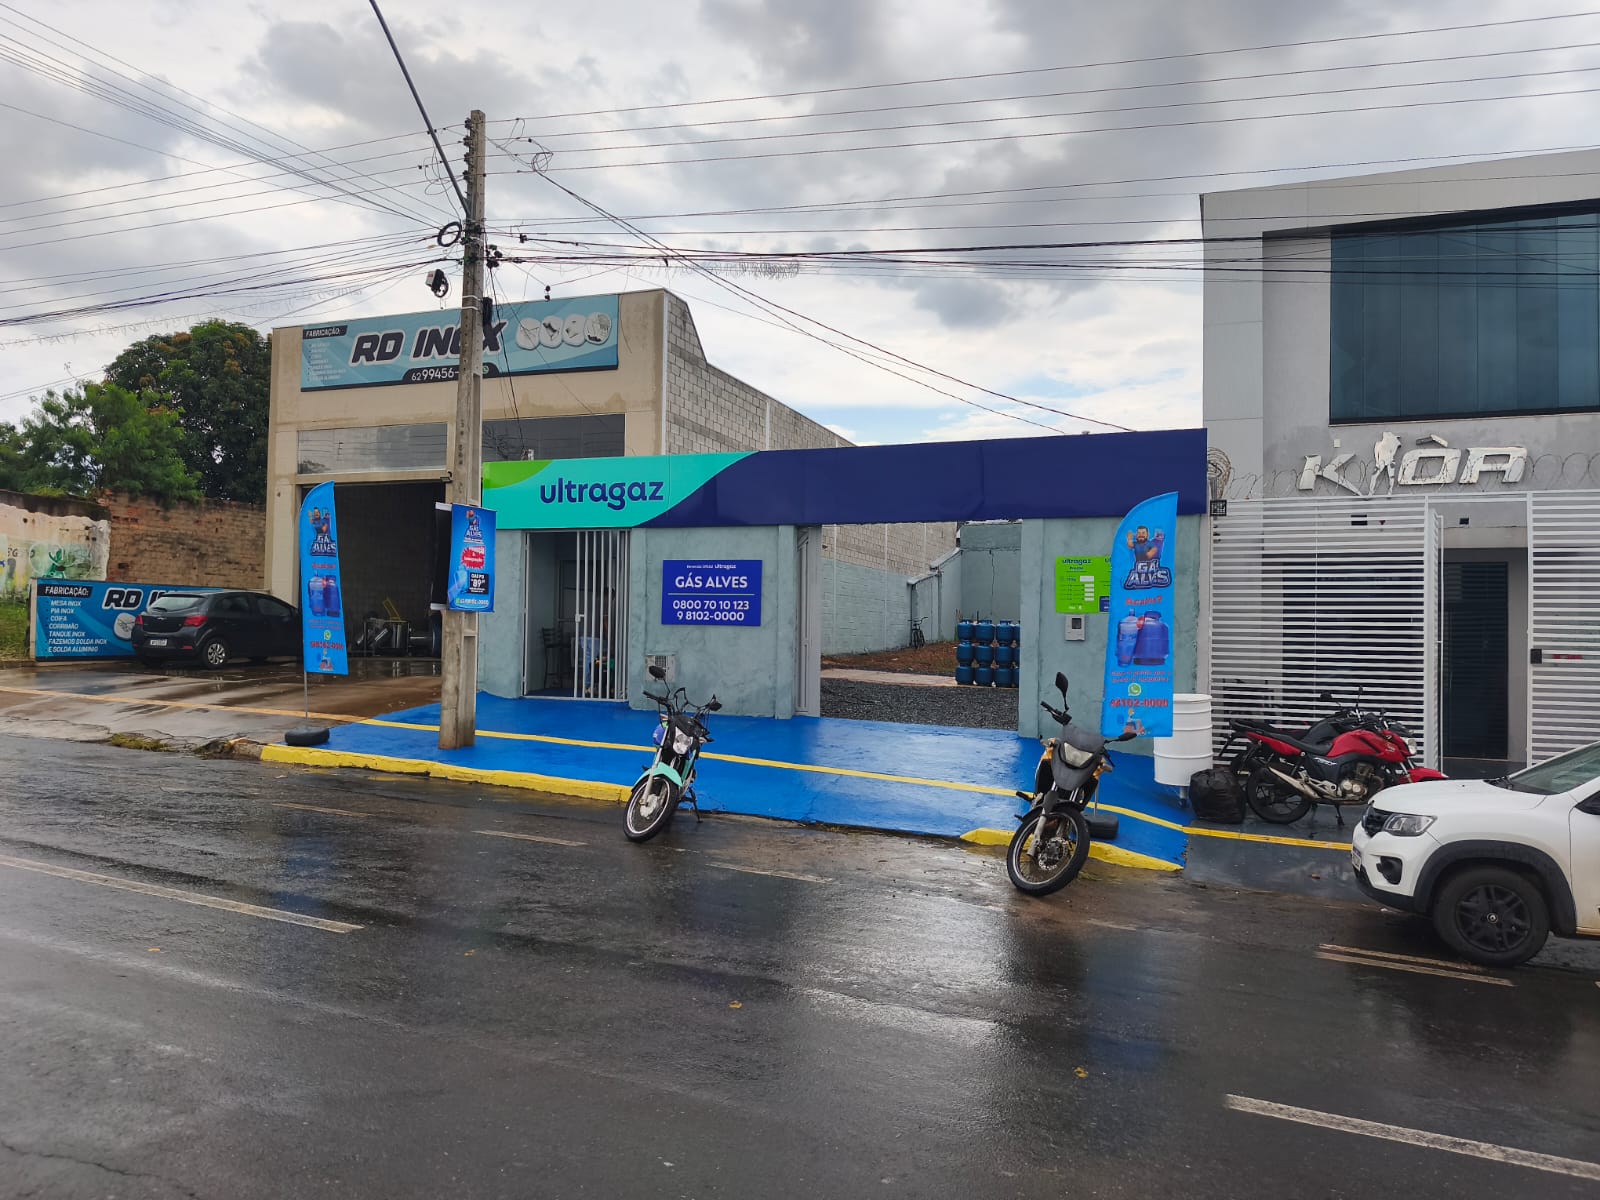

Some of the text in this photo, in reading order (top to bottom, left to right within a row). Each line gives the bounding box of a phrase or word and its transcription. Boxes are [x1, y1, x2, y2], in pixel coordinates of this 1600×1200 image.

[350, 330, 405, 365] RD
[540, 477, 664, 511] ultragaz
[675, 572, 748, 589] GÁS ALVES
[45, 586, 89, 597] FABRICAÇÃO:
[103, 588, 142, 609] RD
[672, 600, 750, 610] 0800 70 10 123
[676, 611, 745, 621] 9 8102-0000
